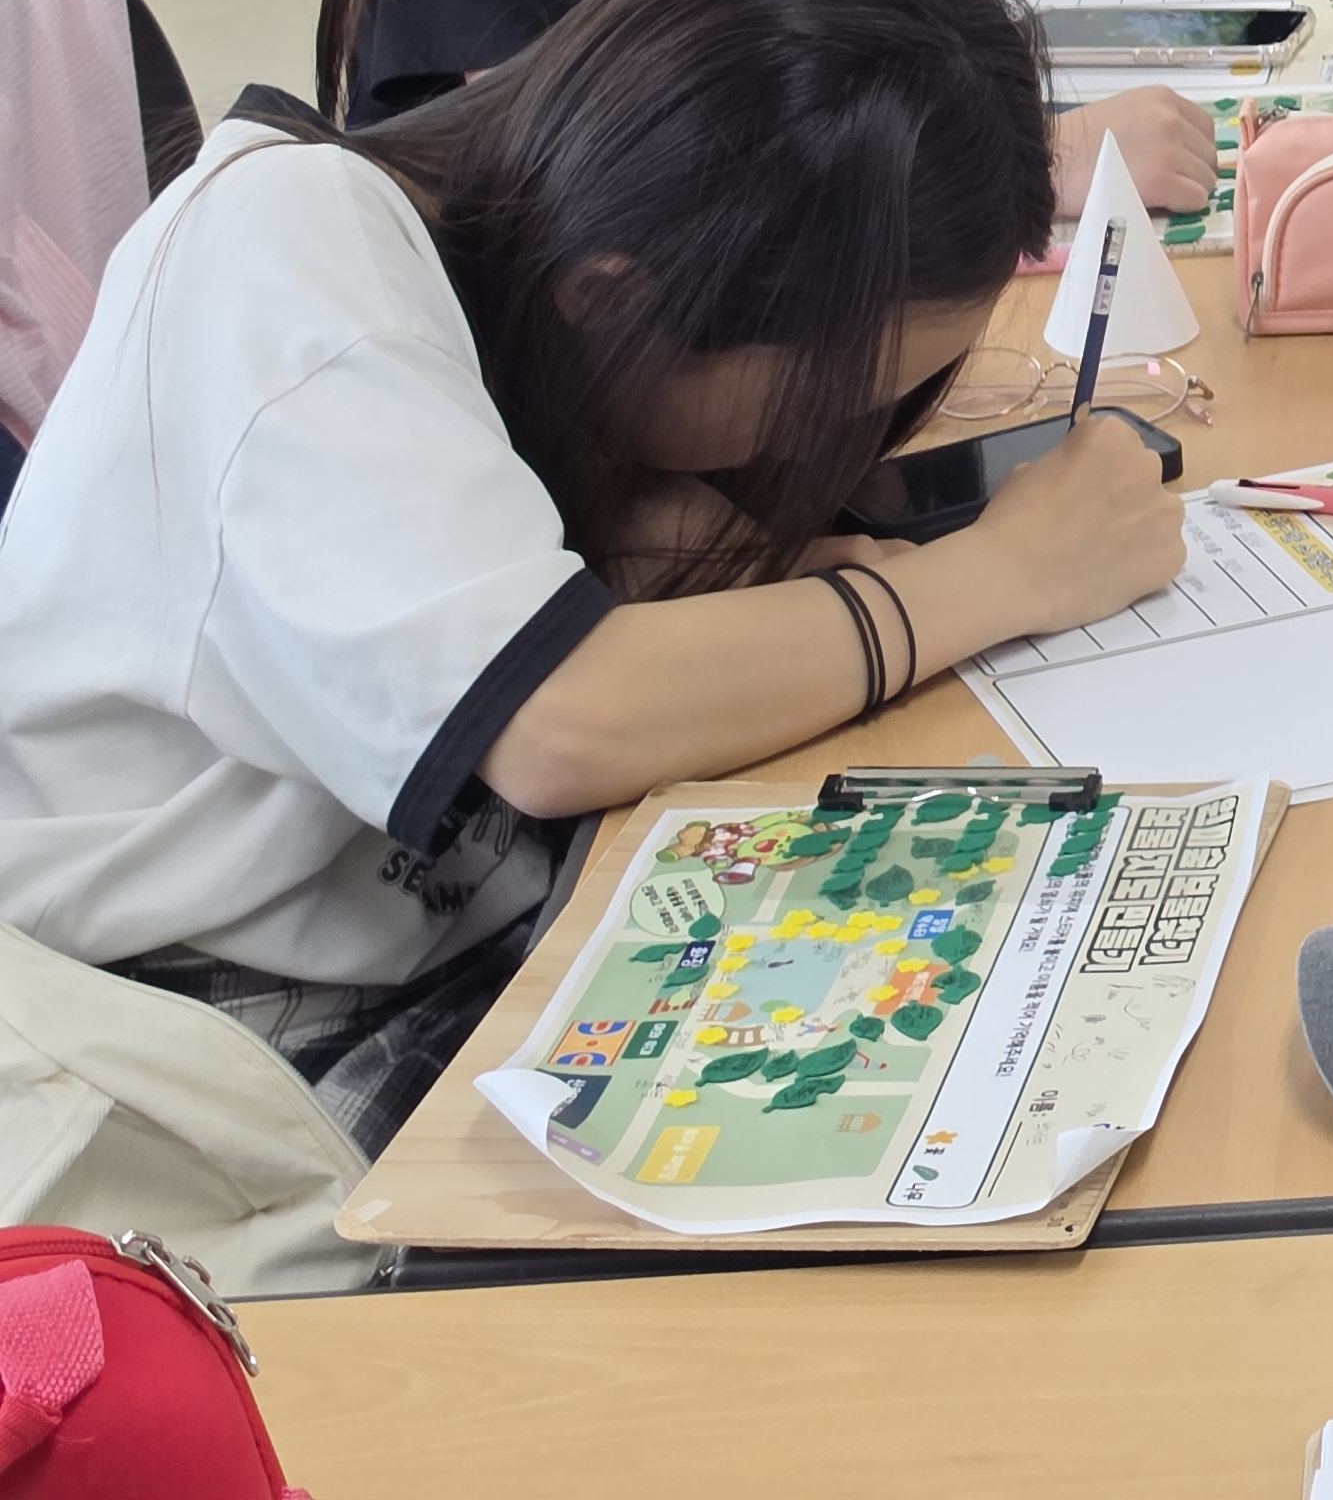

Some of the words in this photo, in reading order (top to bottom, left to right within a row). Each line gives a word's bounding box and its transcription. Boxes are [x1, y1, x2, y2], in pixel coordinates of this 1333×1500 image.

[1125, 805, 1191, 851] 보물
[1172, 795, 1239, 870] 원미숲
[1107, 854, 1173, 901] 지도
[1080, 904, 1142, 974] 만들기
[1138, 873, 1221, 965] 보물찾기
